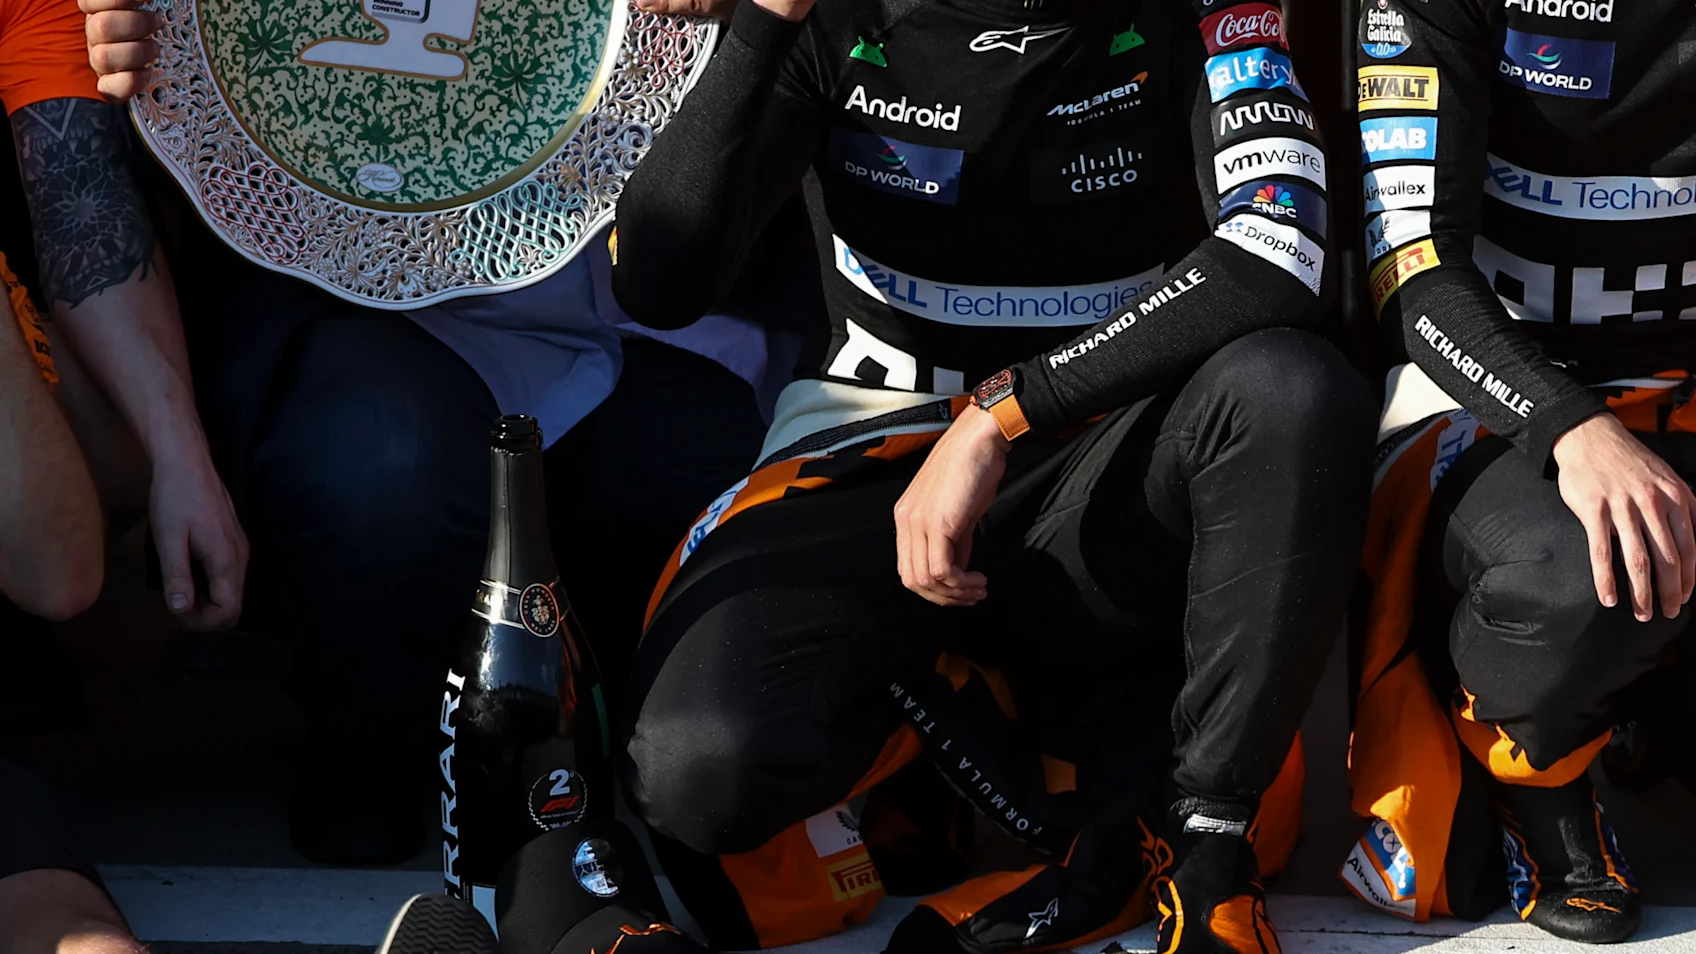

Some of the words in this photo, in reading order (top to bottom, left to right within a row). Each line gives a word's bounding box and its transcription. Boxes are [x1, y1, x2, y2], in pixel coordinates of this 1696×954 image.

[372, 4, 421, 17] CONSTRUCTOR
[1367, 8, 1405, 27] Estrella
[1367, 24, 1402, 43] Galicia
[1358, 78, 1430, 99] EWALT
[1499, 59, 1523, 78] DP
[1523, 69, 1593, 90] WORLD
[844, 84, 962, 132] Android
[1046, 81, 1140, 117] McLaren
[1067, 110, 1105, 127] FORMULA
[1117, 99, 1142, 112] TEAM
[1362, 127, 1428, 153] OLAB
[844, 159, 868, 178] DP
[870, 167, 940, 195] WORLD
[1223, 149, 1321, 175] vmware
[1070, 169, 1139, 194] CISCO
[1365, 180, 1426, 202] Airwallex
[1244, 225, 1317, 273] Dropbox
[843, 246, 928, 309] DELL
[935, 278, 1154, 320] Technologies
[1372, 247, 1426, 303] RELLI
[1049, 311, 1138, 370] RICHARD
[1138, 267, 1208, 316] MILLE
[1414, 314, 1485, 384] RICHARD
[1482, 371, 1536, 419] MILLE
[889, 682, 936, 734] TEAM
[439, 668, 467, 900] RRARI
[958, 756, 1043, 836] FORMULA
